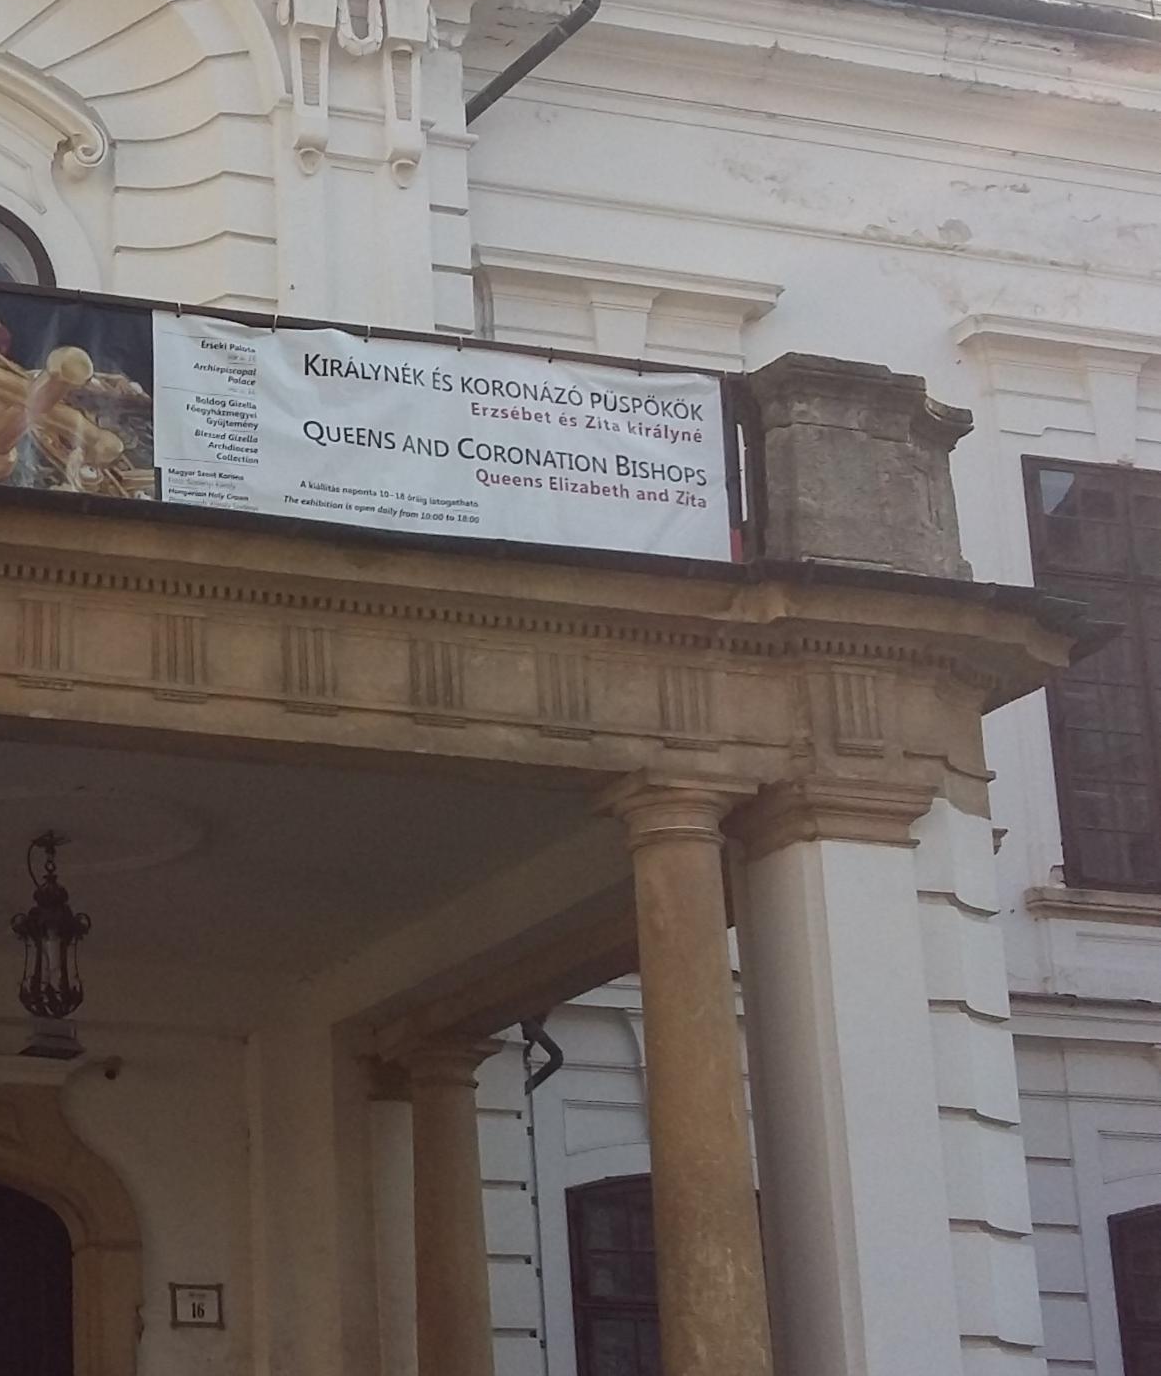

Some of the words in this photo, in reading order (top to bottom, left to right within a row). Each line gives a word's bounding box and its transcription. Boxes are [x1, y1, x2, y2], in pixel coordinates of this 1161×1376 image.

[304, 353, 425, 387] KIRÁLYNÉK
[432, 367, 453, 393] ÉS
[460, 375, 583, 408] KORONÁZÓ
[590, 389, 704, 422] PÜSPÖKÖK
[471, 402, 552, 424] Erzsébet
[558, 411, 577, 427] és
[585, 414, 620, 432] Zita
[627, 420, 703, 444] királyné
[303, 420, 396, 450] QUEENS
[402, 435, 449, 458] AND
[457, 437, 608, 474] CORONATION
[615, 454, 708, 487] BISHOPS
[299, 480, 307, 489] A
[475, 468, 543, 490] Queens
[549, 475, 630, 500] Elizabeth
[636, 486, 669, 504] and
[675, 490, 708, 509] Zita
[283, 495, 299, 505] The
[300, 497, 344, 510] exhibition
[345, 503, 353, 511] is
[354, 504, 376, 516] open
[377, 505, 398, 517] daily
[398, 508, 419, 520] from
[420, 511, 444, 522] 10:00
[446, 514, 455, 522] to
[191, 1302, 205, 1319] 16
